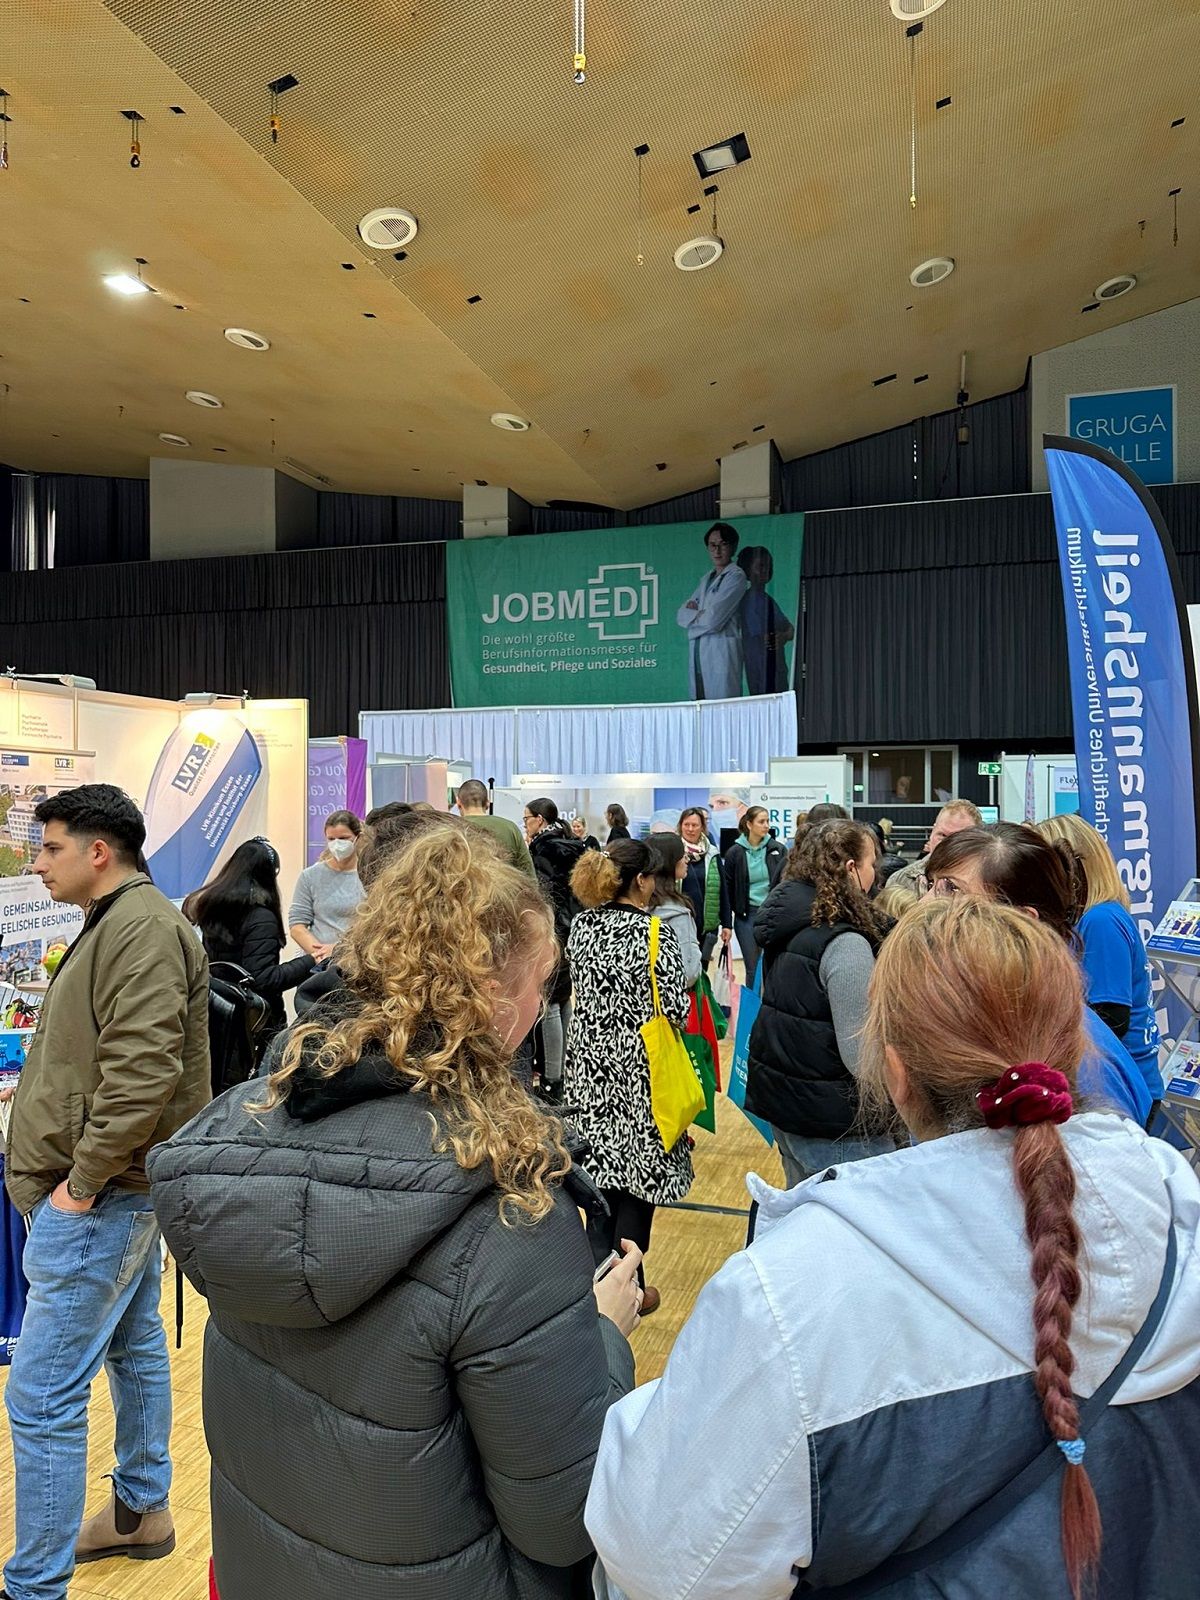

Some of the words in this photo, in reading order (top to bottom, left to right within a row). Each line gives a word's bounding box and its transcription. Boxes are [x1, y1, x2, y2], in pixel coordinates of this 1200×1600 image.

[1076, 414, 1167, 439] GRUGA
[1107, 442, 1161, 463] LLE
[481, 585, 649, 624] JOBMEDI
[482, 635, 501, 645] Die
[504, 633, 533, 644] wohl
[536, 632, 575, 646] größte
[482, 646, 636, 660] Berufsinformationsmesse
[639, 642, 658, 653] für
[482, 662, 548, 674] Gesundheit,
[550, 660, 584, 674] Pflege
[587, 659, 609, 670] und
[611, 656, 657, 669] Soziales
[175, 753, 203, 789] LVR
[4, 900, 51, 917] GEMEINSAM
[1, 917, 40, 935] EELISCHE
[41, 911, 84, 928] GESUNDHEI
